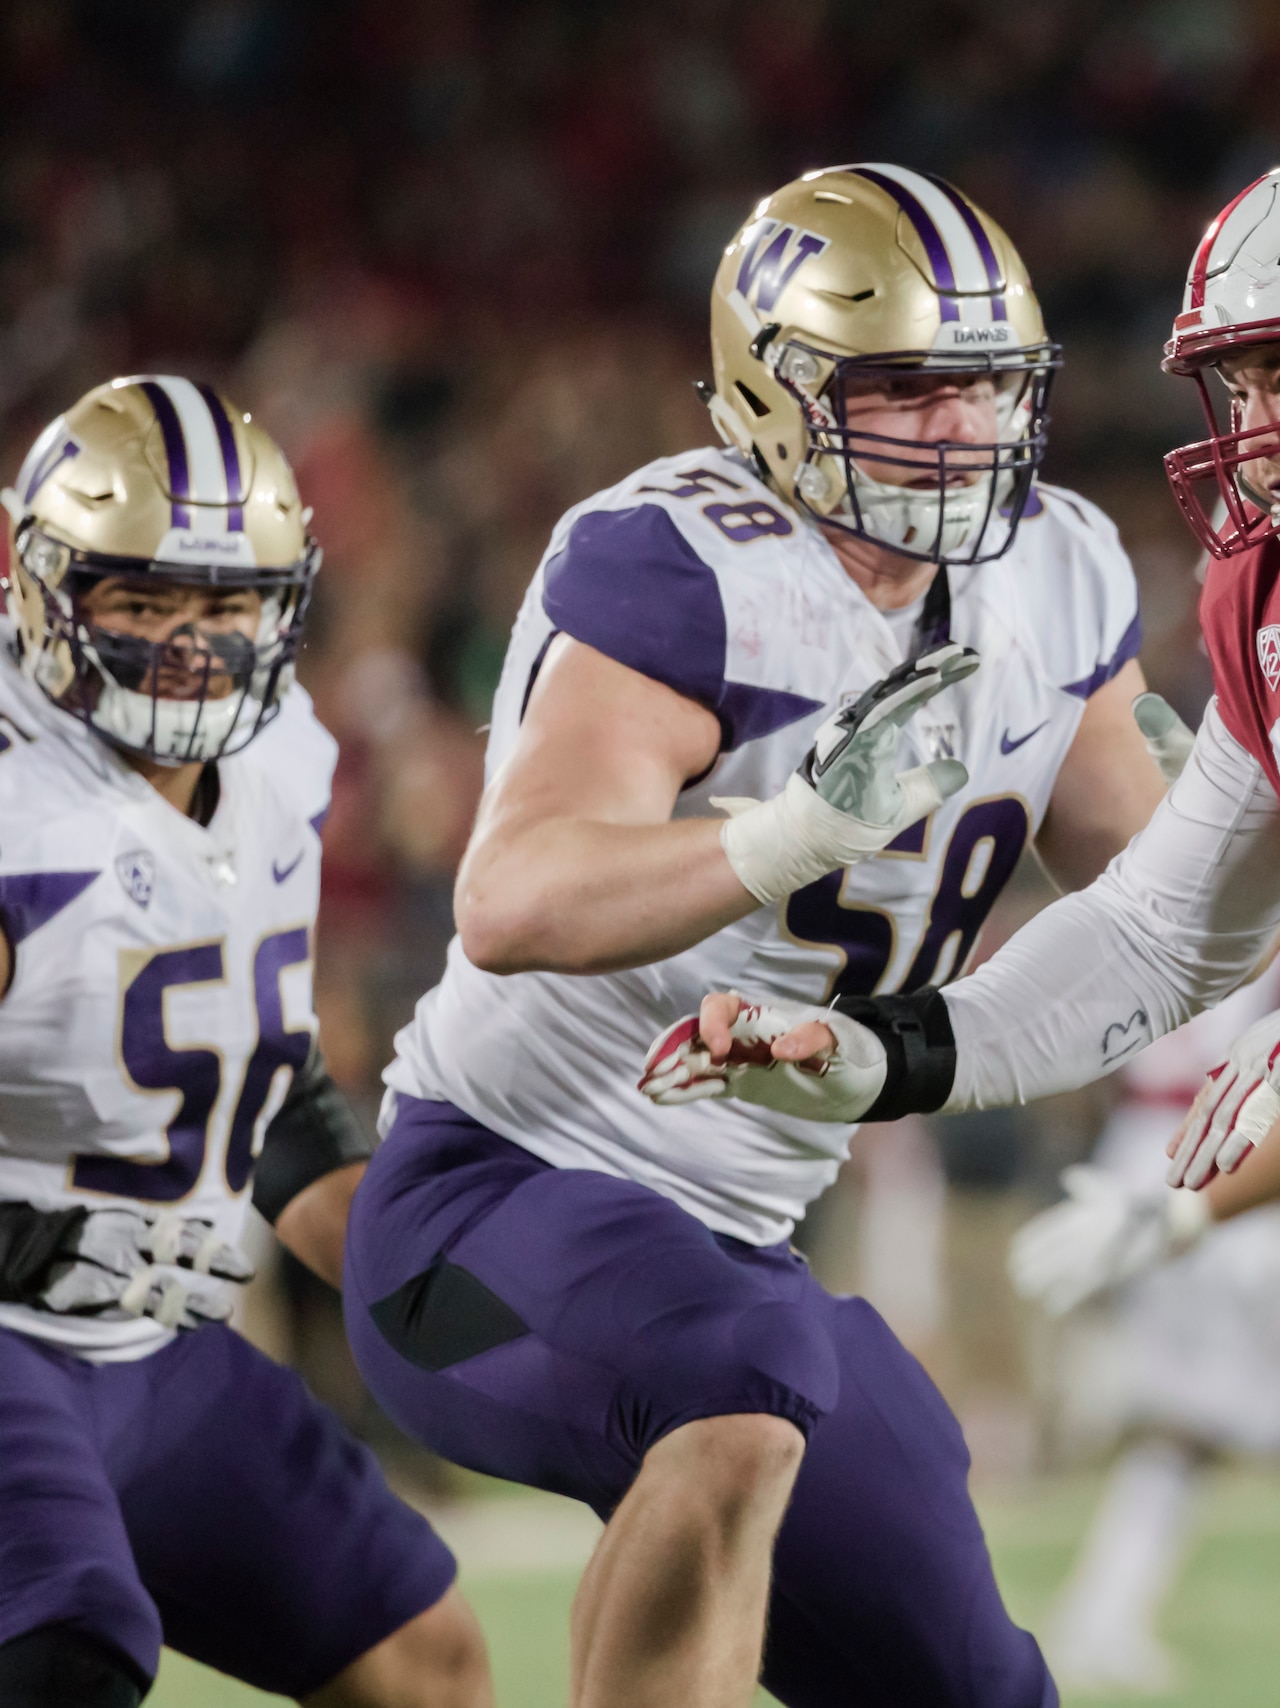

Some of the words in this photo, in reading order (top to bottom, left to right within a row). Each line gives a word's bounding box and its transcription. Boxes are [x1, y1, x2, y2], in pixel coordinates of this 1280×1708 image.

[736, 217, 831, 315] W
[633, 468, 794, 544] 58
[1266, 652, 1280, 677] 12
[65, 925, 313, 1203] 56
